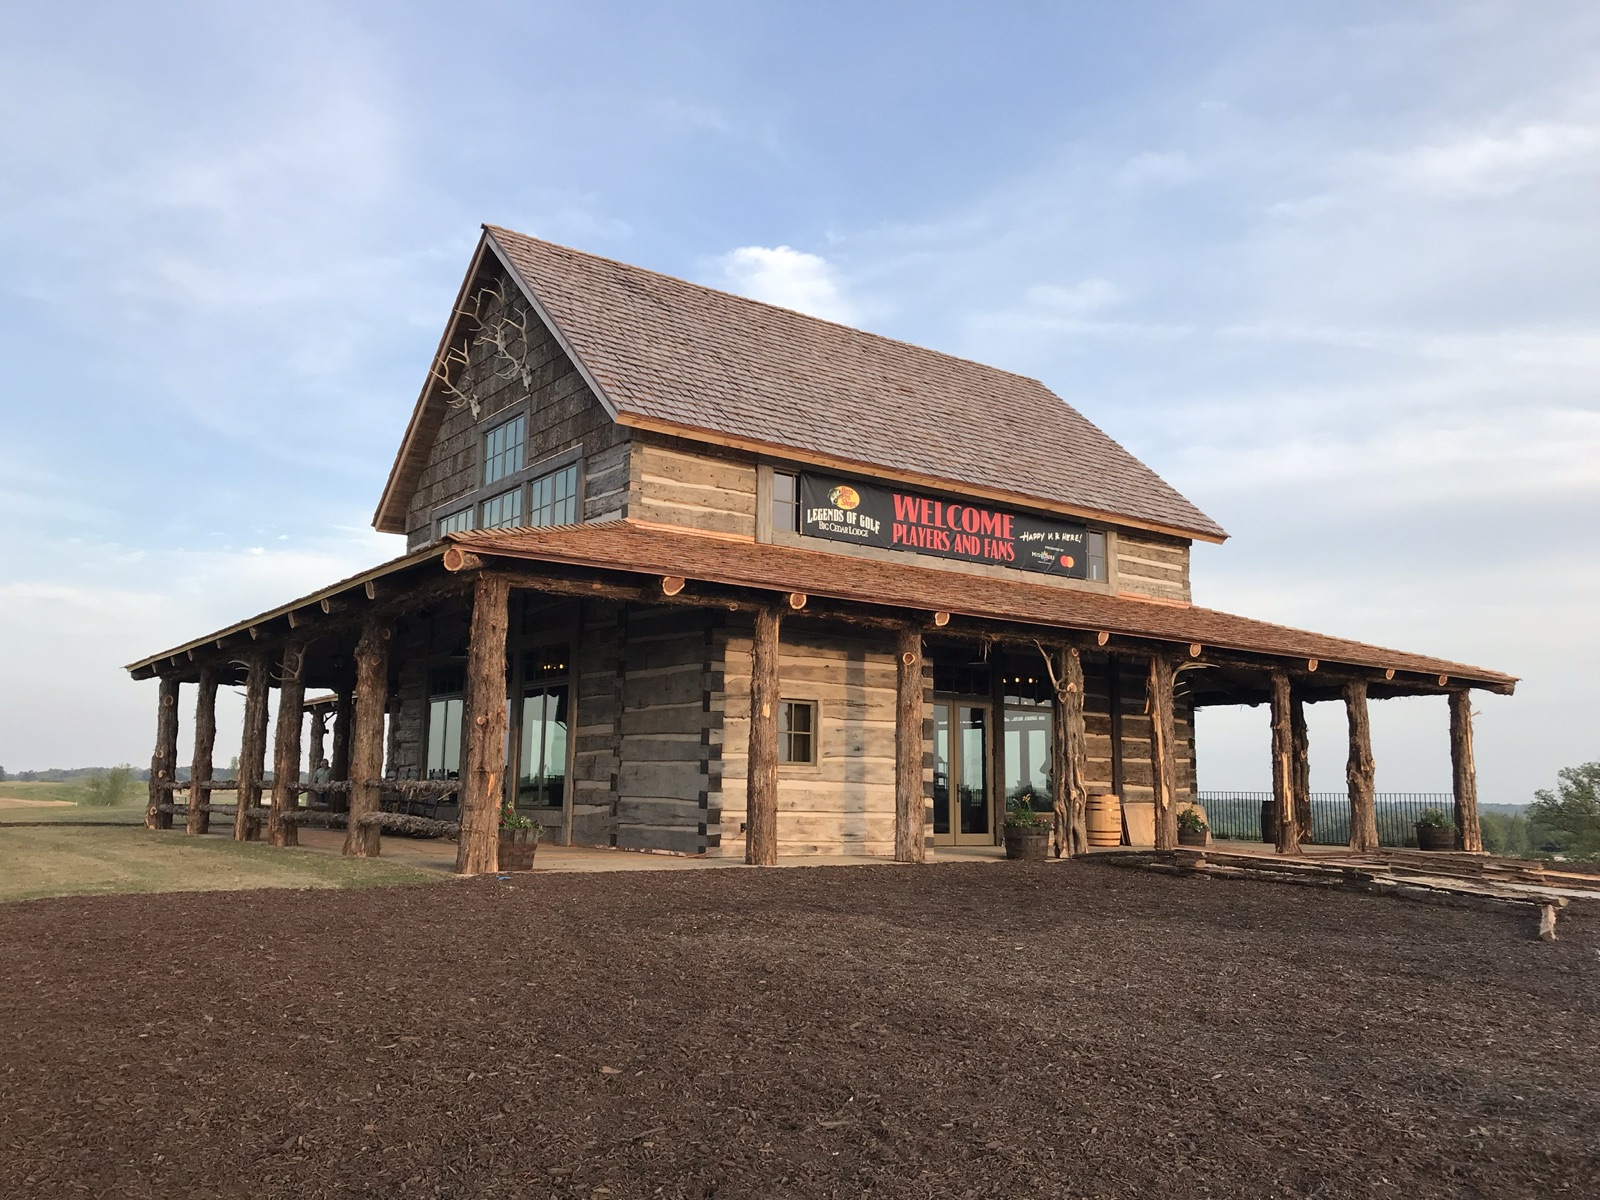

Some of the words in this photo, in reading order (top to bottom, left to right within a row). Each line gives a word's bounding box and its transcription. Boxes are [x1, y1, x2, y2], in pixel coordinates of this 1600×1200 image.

[807, 508, 844, 524] LEGENDS
[846, 511, 857, 525] OF
[859, 514, 881, 535] GOLF
[829, 522, 848, 534] CEDAR
[848, 525, 869, 537] LODGE
[893, 493, 1015, 540] WELCOME
[892, 522, 950, 552] PLAYERS
[954, 533, 981, 556] AND
[983, 538, 1015, 562] FANS
[1019, 531, 1046, 542] HAPPY
[1054, 532, 1060, 541] R
[1061, 532, 1083, 544] HERE!
